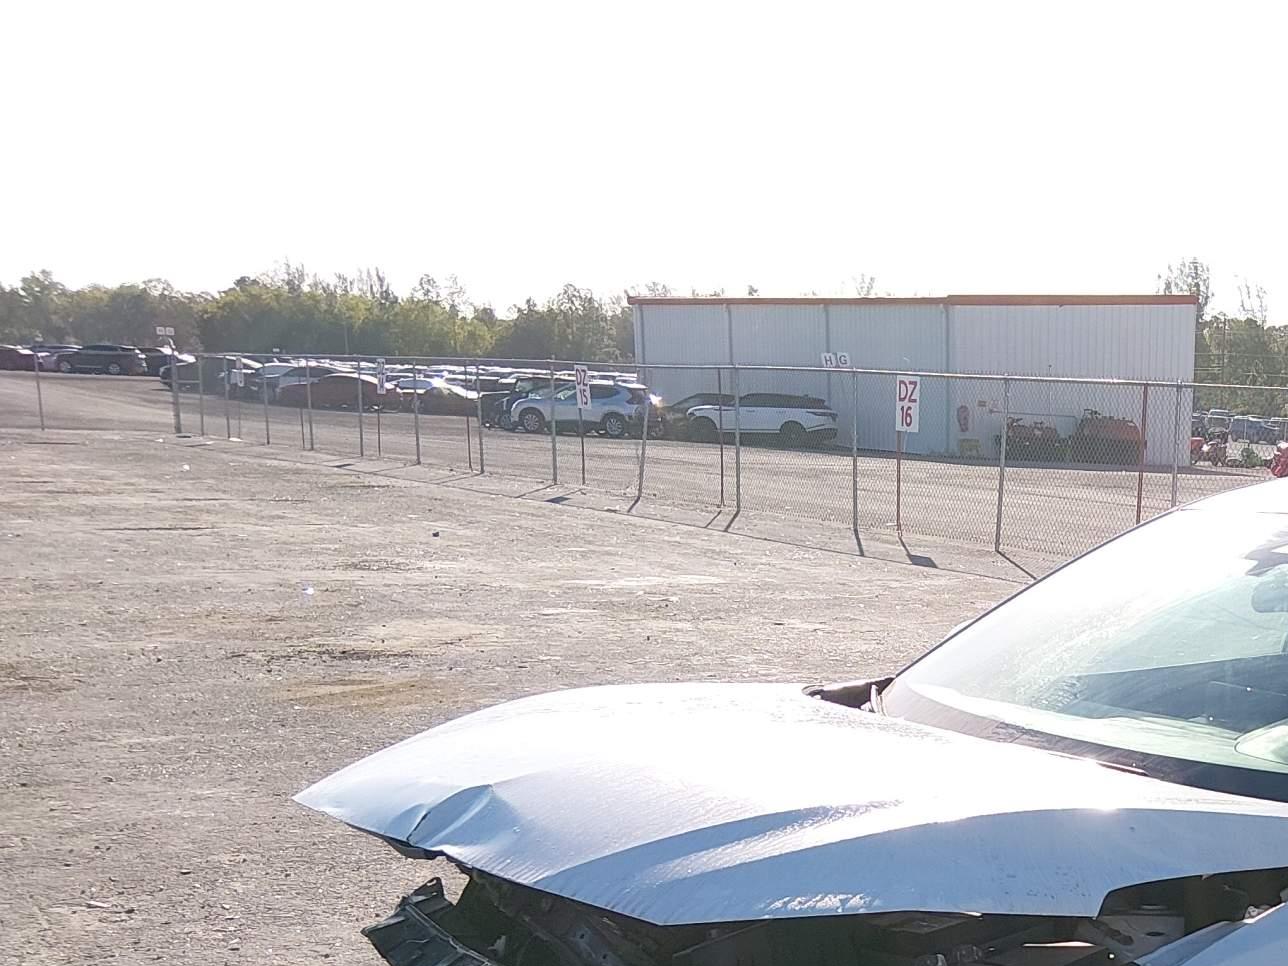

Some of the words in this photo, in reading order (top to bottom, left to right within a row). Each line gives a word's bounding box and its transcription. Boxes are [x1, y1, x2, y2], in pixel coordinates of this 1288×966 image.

[576, 368, 588, 387] DZ
[580, 388, 588, 406] 15
[898, 380, 918, 403] DZ
[900, 406, 913, 428] 16
